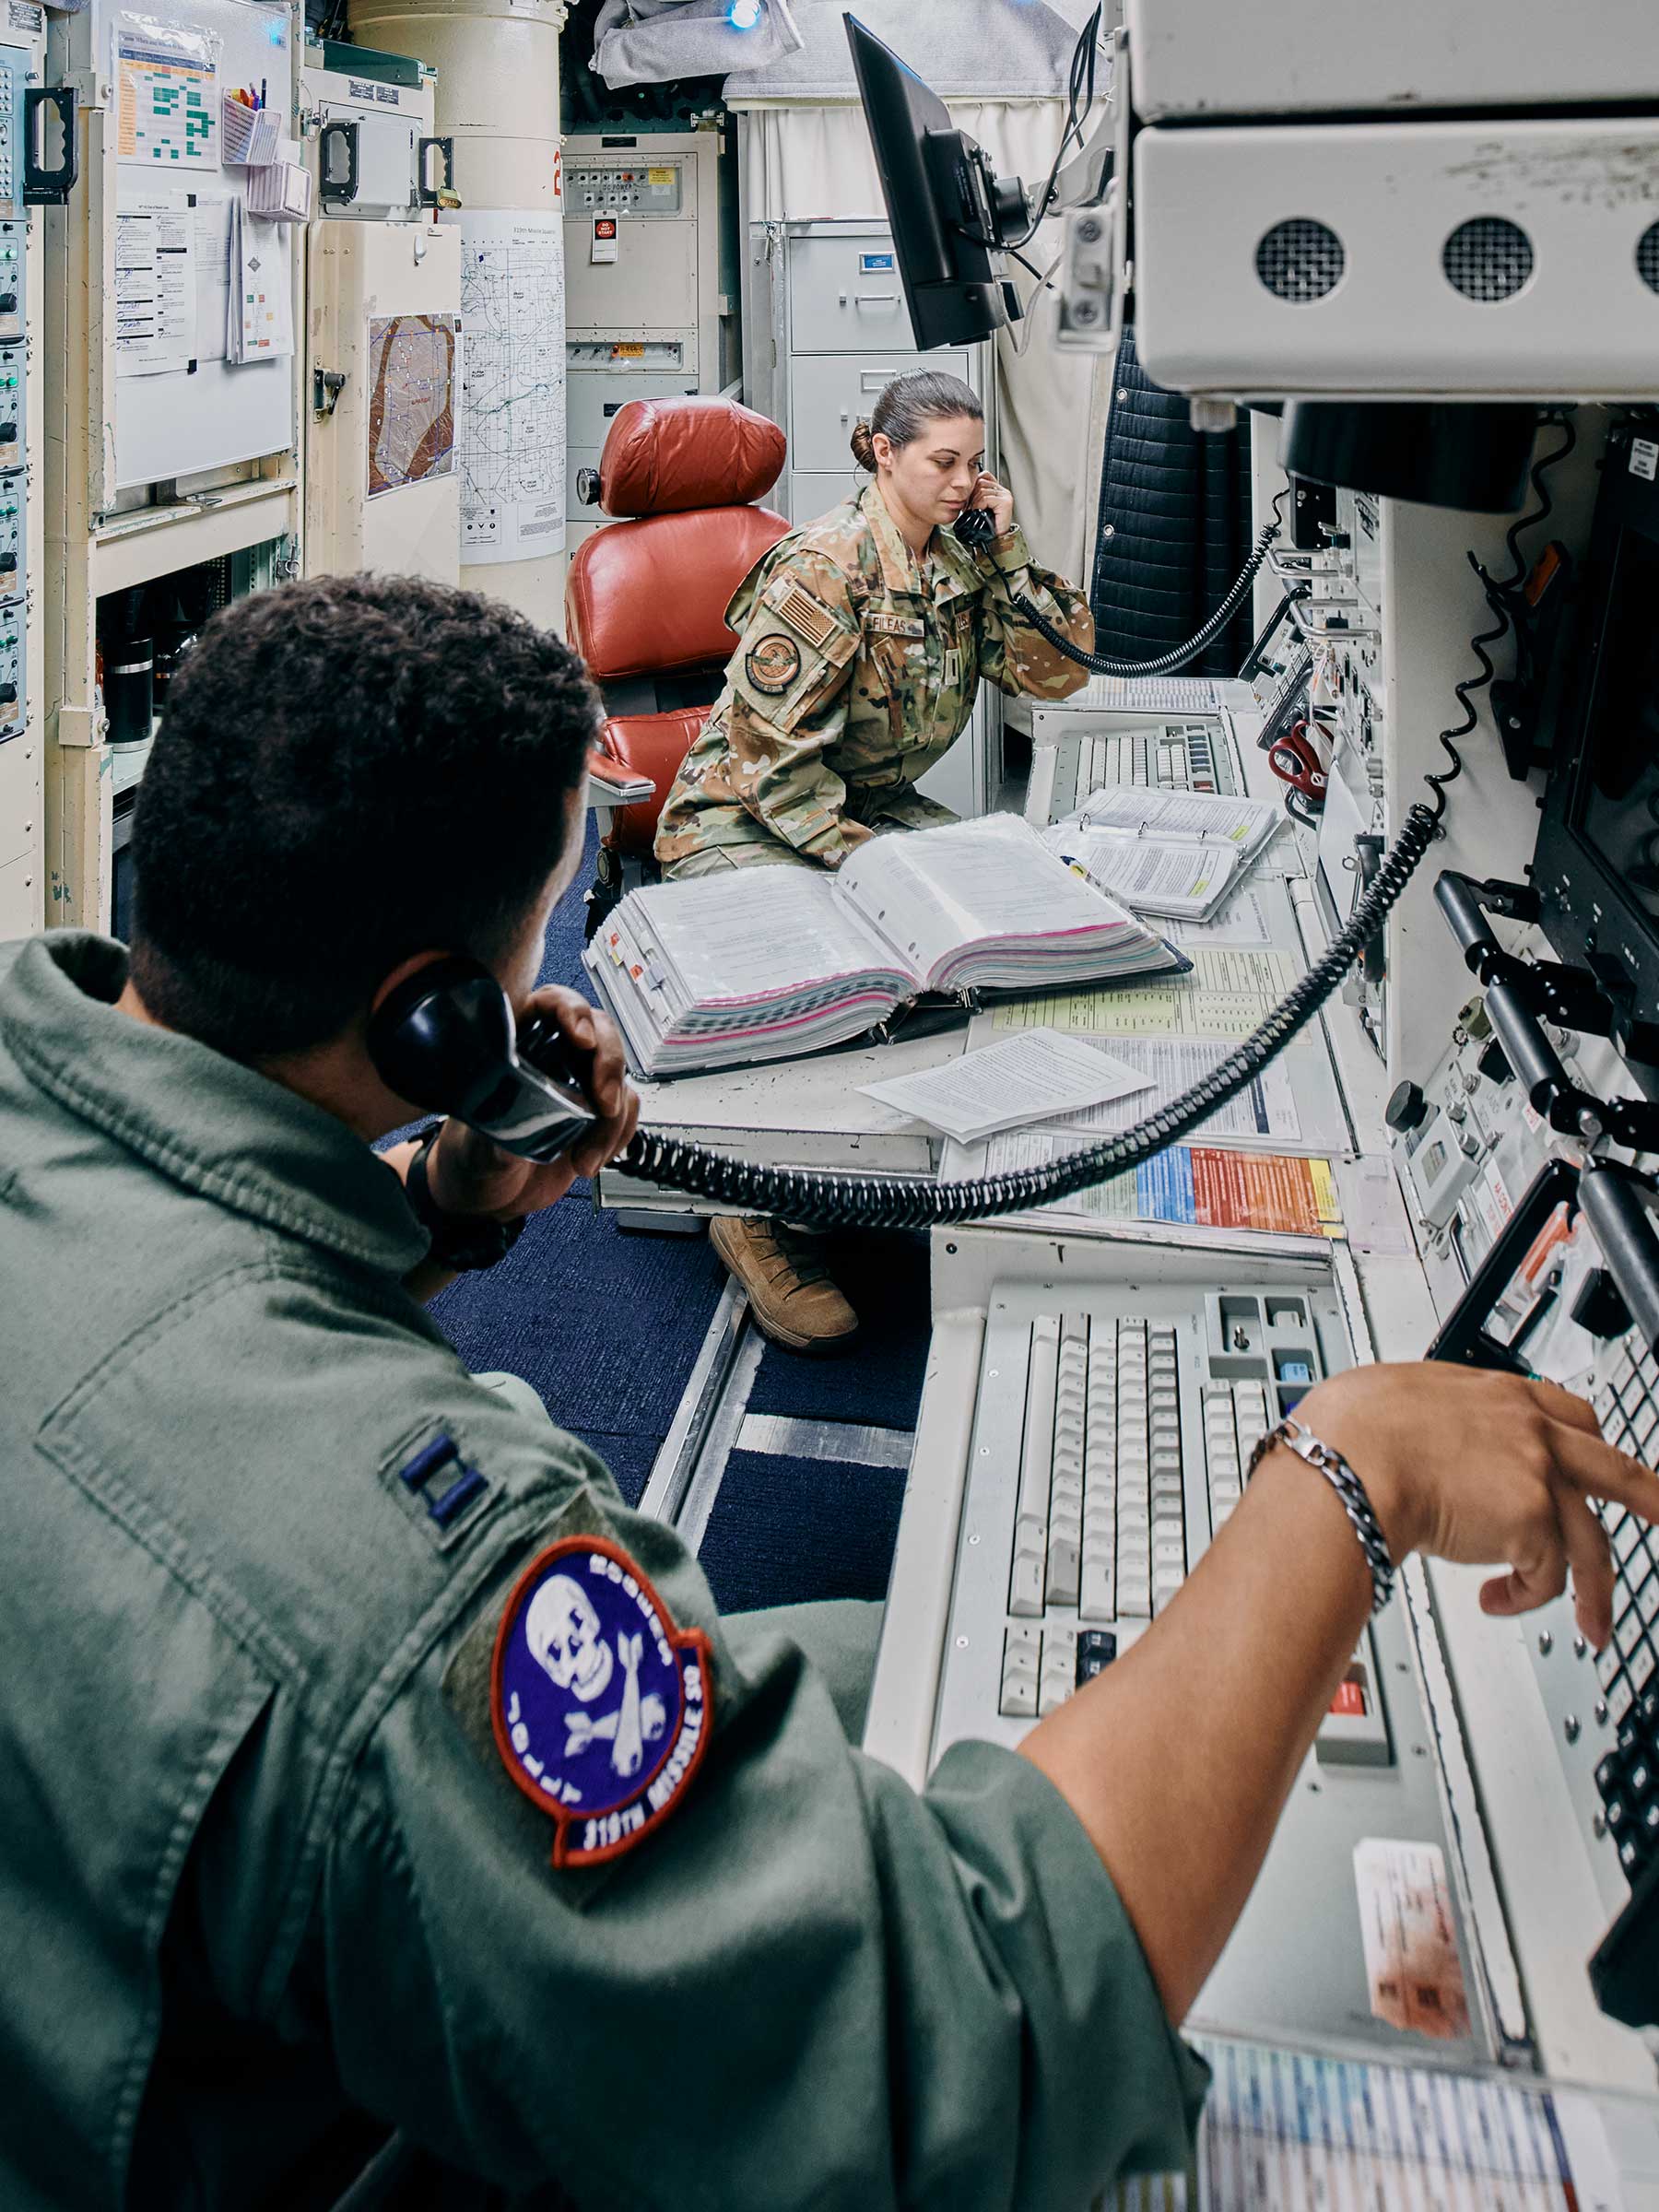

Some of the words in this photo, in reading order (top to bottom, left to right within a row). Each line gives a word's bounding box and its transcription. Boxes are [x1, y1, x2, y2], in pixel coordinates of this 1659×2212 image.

[872, 617, 906, 634] FILEAS
[508, 1690, 582, 1804] JOLLY
[582, 1800, 646, 1852] 319TH
[648, 1706, 703, 1812] MISSILE
